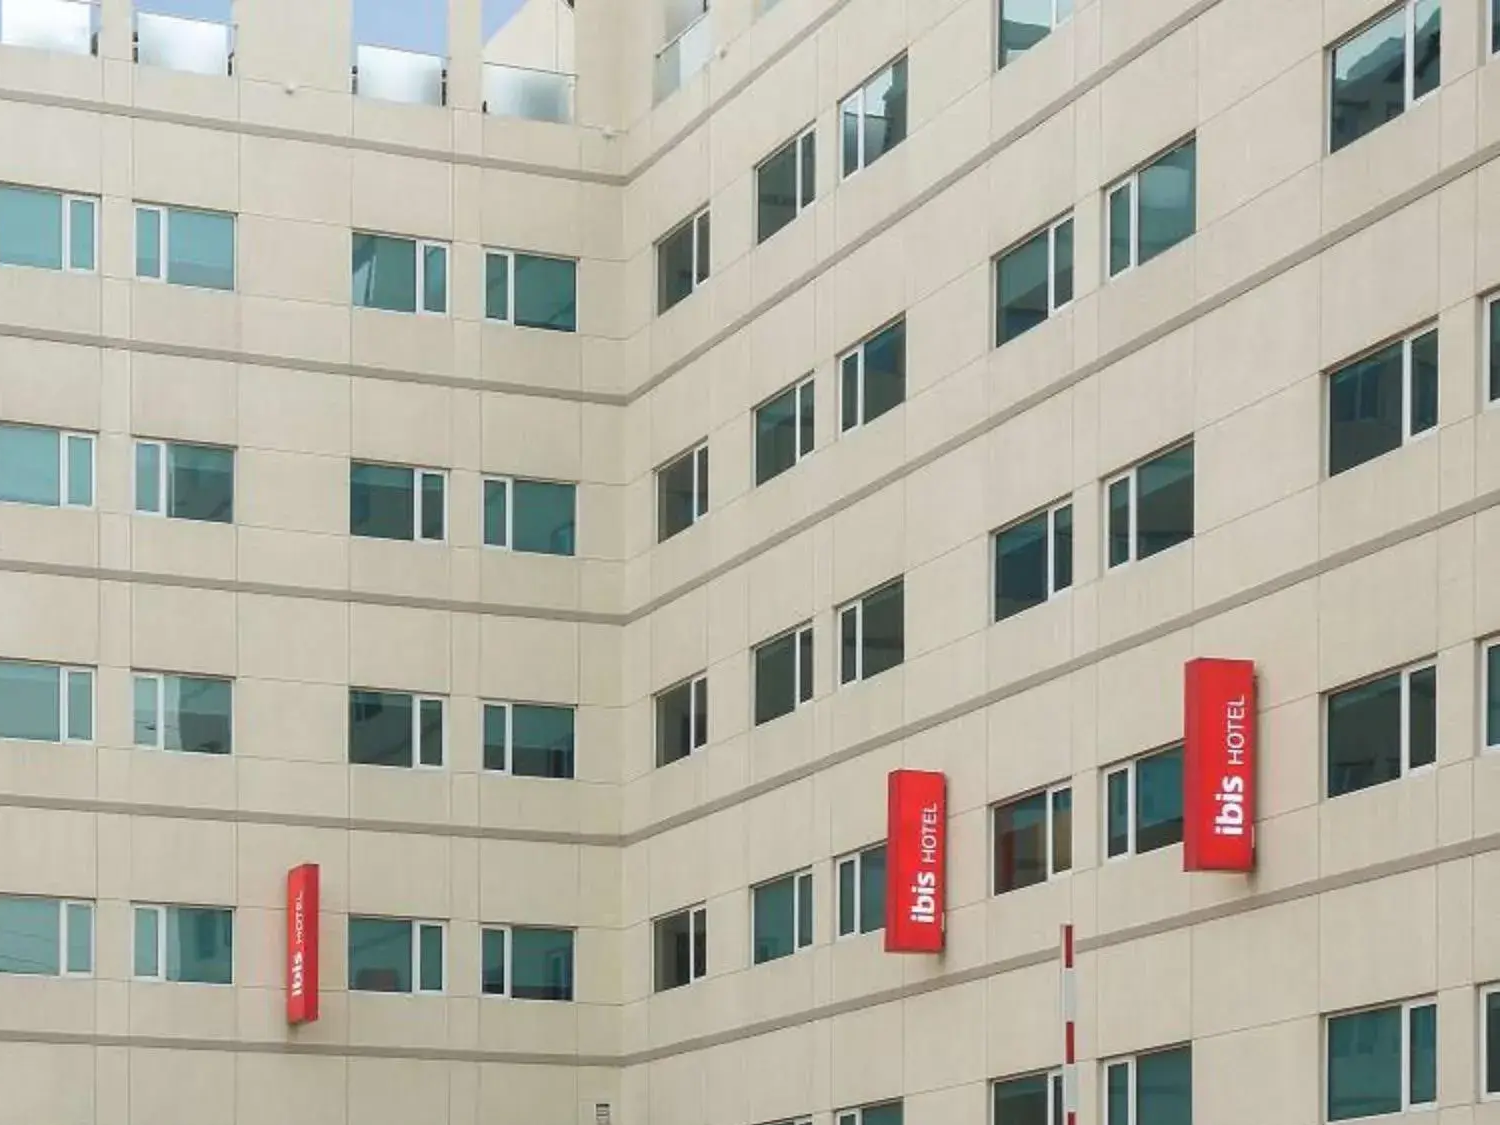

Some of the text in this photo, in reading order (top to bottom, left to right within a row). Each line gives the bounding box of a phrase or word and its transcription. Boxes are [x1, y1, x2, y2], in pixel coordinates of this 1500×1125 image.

[1214, 695, 1245, 835] ibis HOTEL
[910, 803, 937, 923] ibis HOTEL
[291, 890, 304, 996] ibis HOTEL
